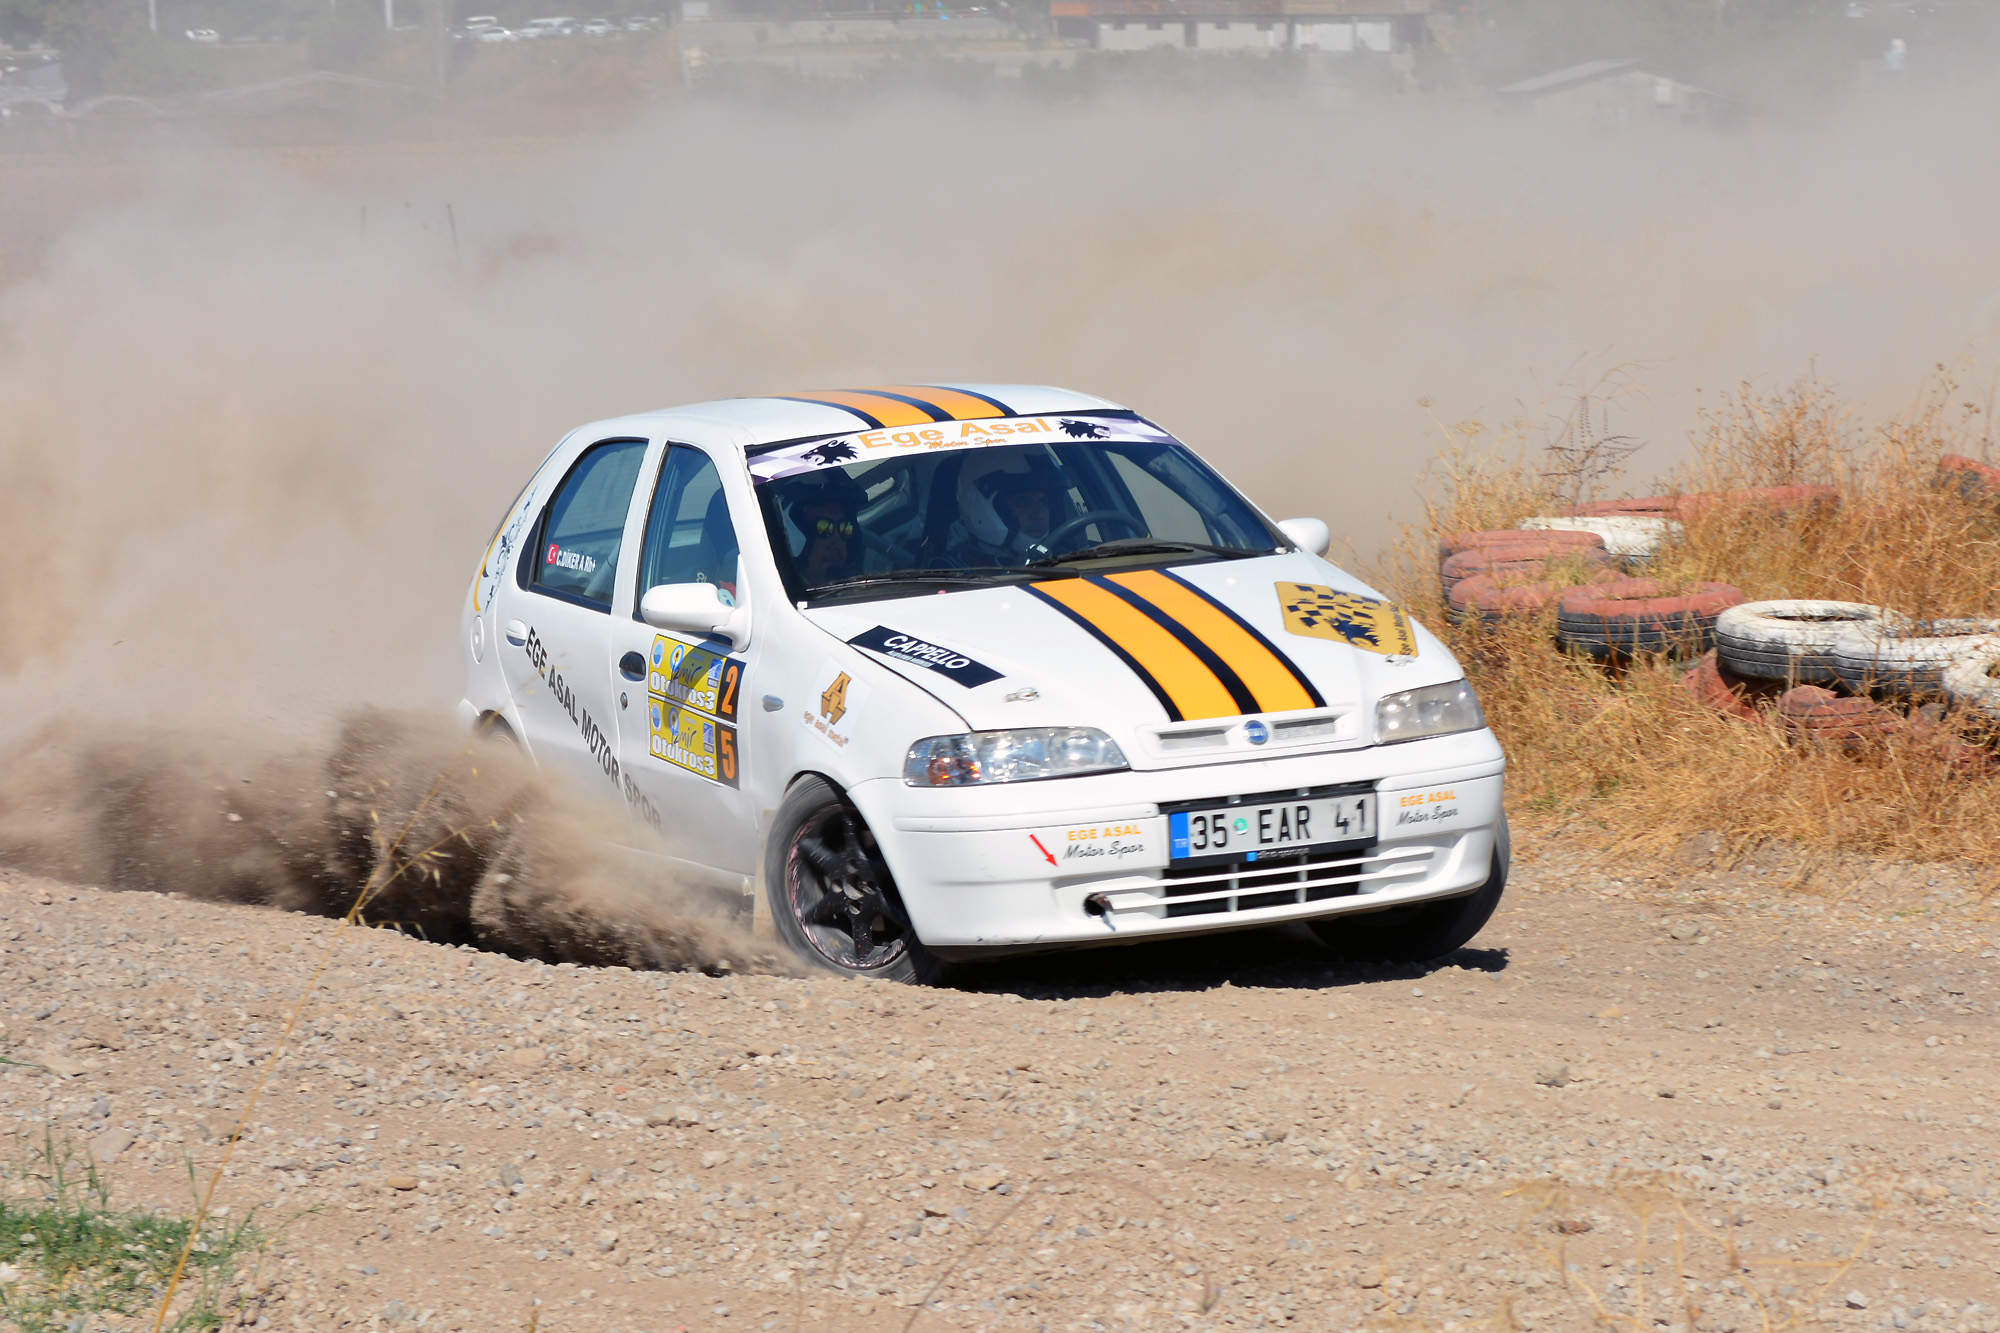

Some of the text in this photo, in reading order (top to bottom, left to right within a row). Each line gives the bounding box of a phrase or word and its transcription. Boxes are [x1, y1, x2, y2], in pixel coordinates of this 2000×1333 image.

[857, 418, 1053, 449] Ege Asal
[923, 436, 1008, 450] Motor Spor
[884, 635, 971, 669] CAPPELLO
[650, 671, 716, 710] Otokros3
[721, 665, 738, 714] 2
[525, 626, 548, 680] EGE
[548, 664, 578, 726] ASAL
[581, 708, 620, 790] MOTOR
[652, 734, 715, 775] Otokros3
[721, 730, 735, 779] 5
[1395, 805, 1459, 826] Motor Spor
[1400, 790, 1456, 808] EGE ASAL
[1068, 824, 1142, 841] EGE ASAL
[1192, 814, 1229, 850] 35
[1258, 805, 1311, 844] EAR
[1063, 840, 1145, 859] Motor Spor
